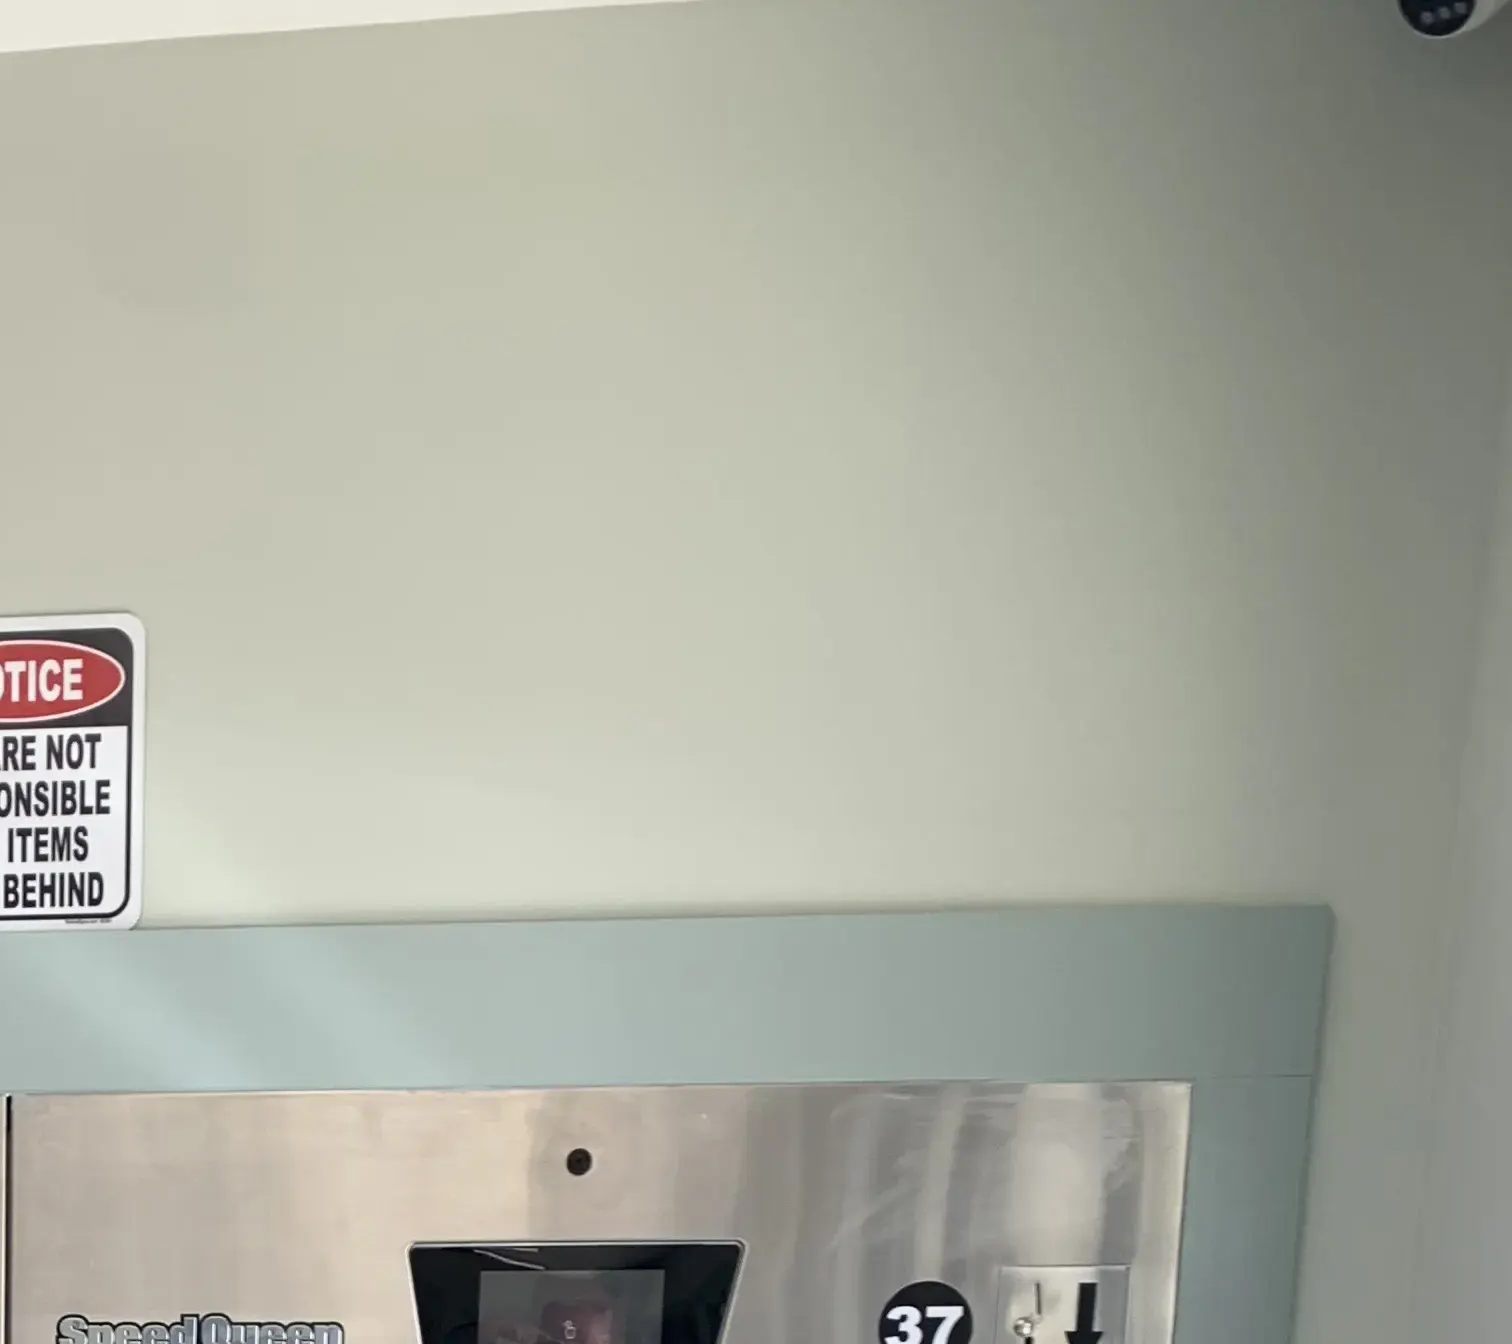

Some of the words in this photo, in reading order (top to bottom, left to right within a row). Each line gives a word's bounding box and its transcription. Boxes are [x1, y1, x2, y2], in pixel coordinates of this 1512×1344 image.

[46, 733, 102, 770] NOT
[7, 826, 89, 863] ITEMS
[3, 872, 104, 909] BEHIND
